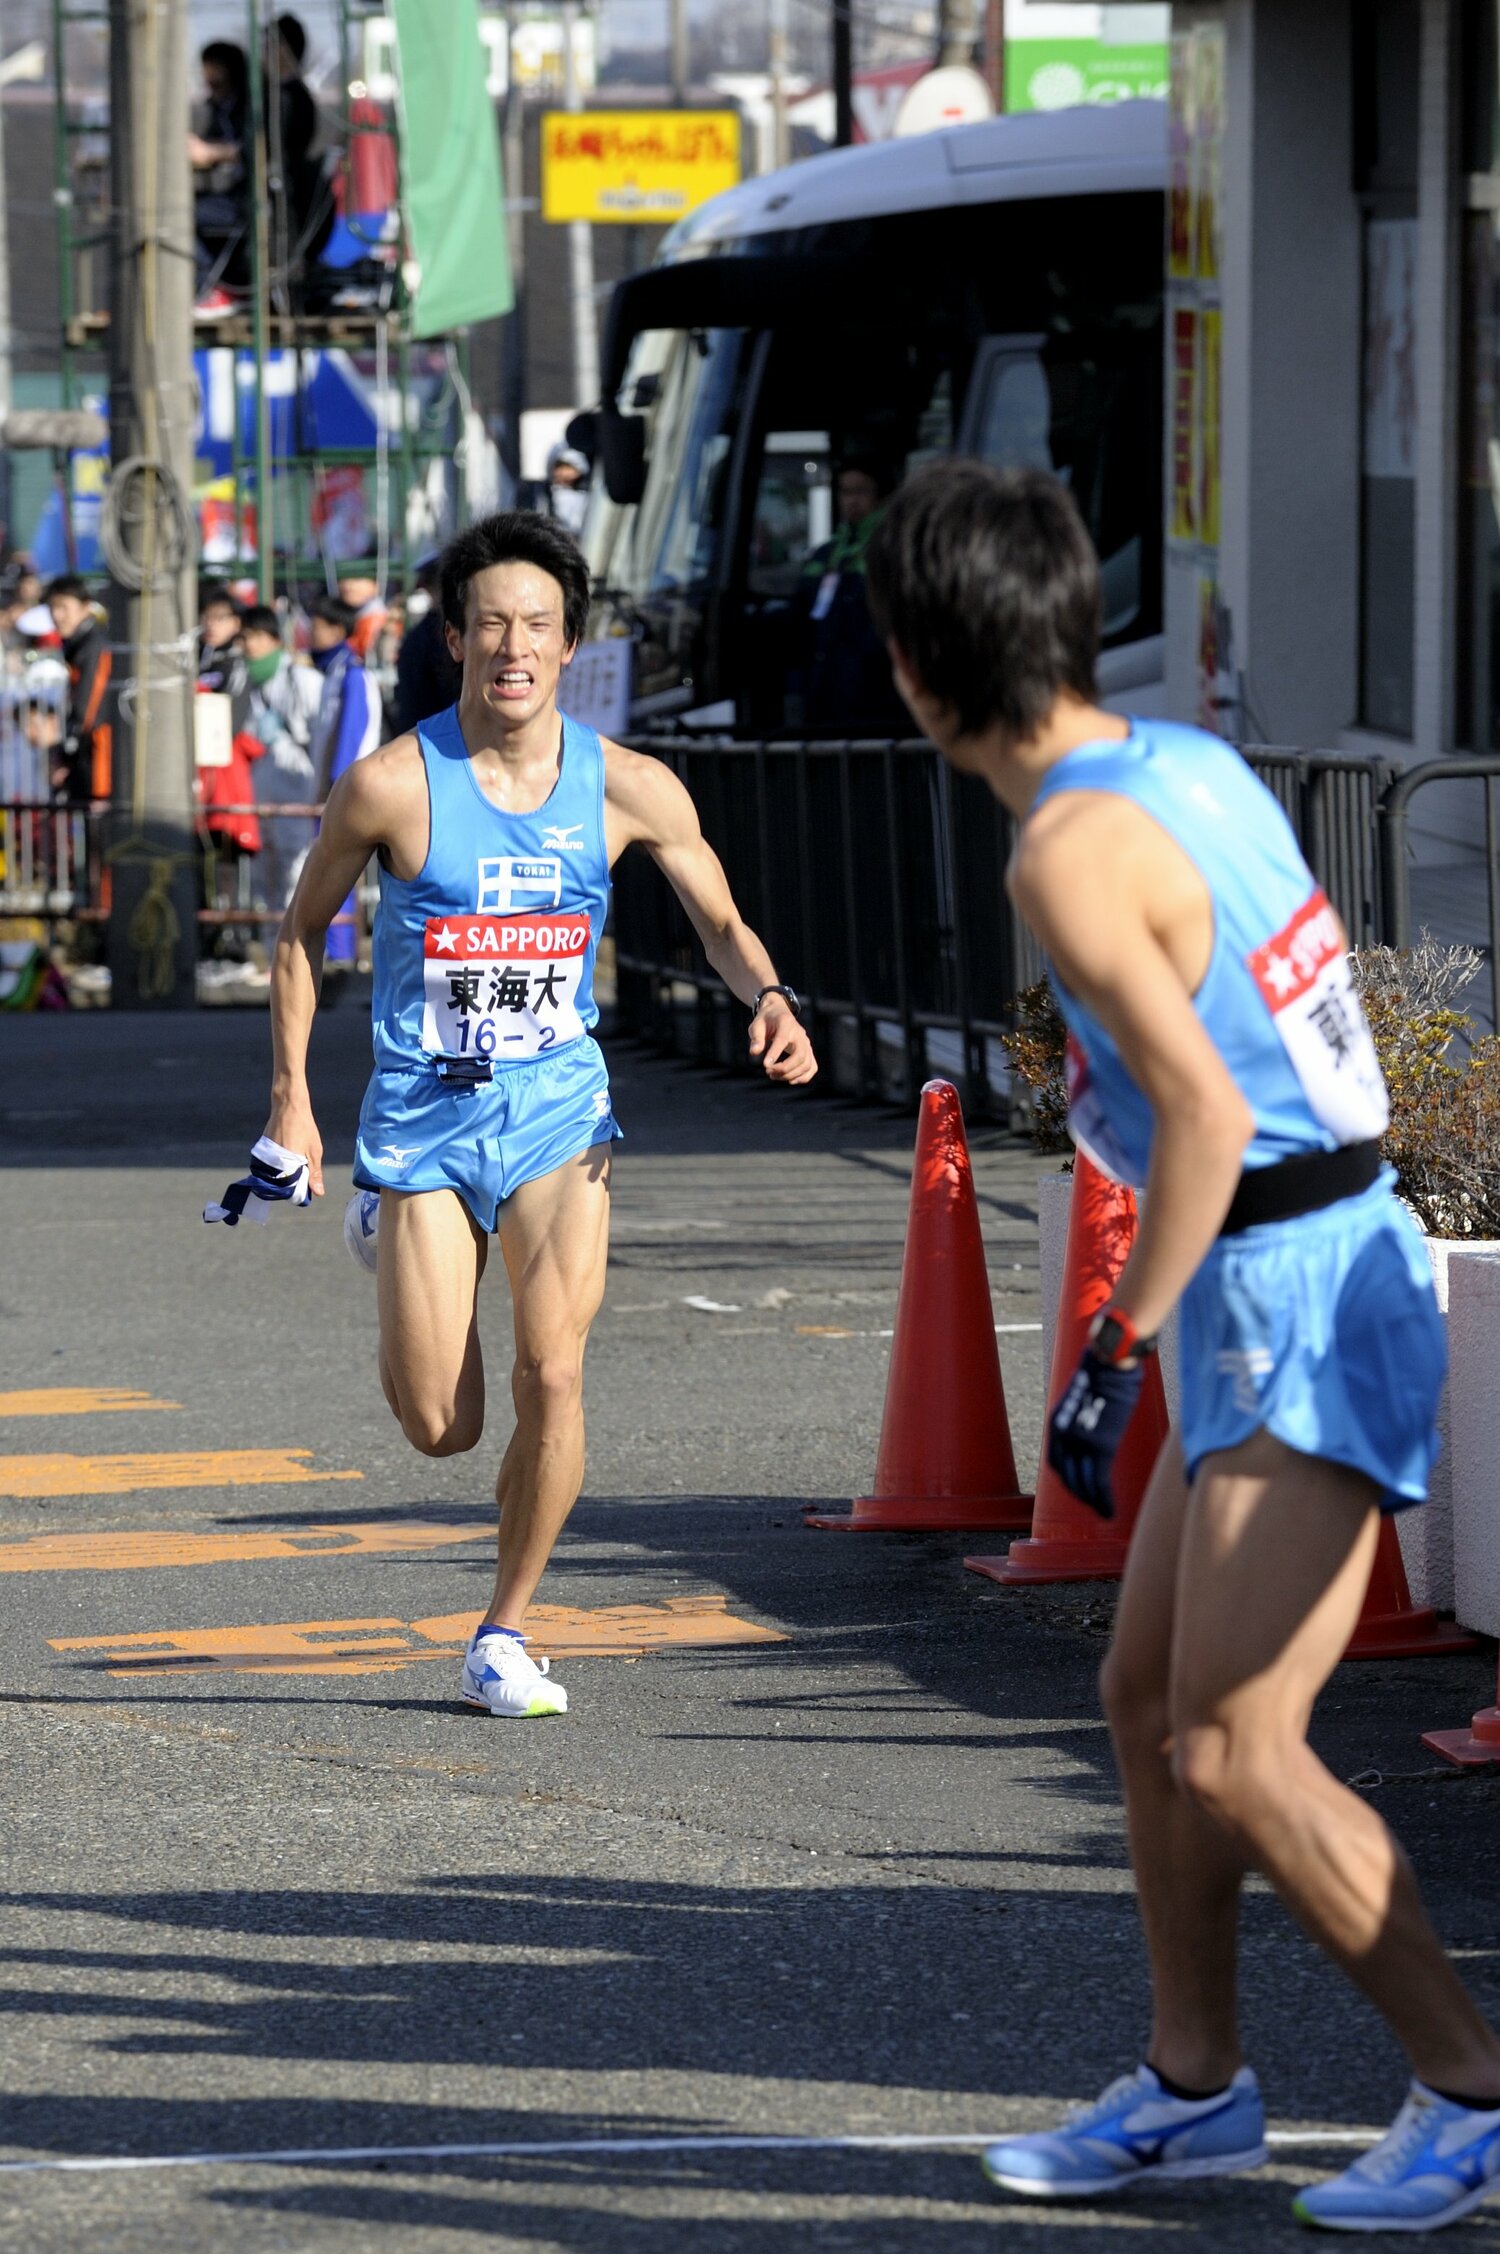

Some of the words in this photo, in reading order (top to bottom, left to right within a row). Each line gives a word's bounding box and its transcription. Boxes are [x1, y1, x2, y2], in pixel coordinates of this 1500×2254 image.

[516, 865, 551, 877] TOKAI
[466, 926, 586, 953] SAPPORO
[445, 963, 567, 1016] 東海大
